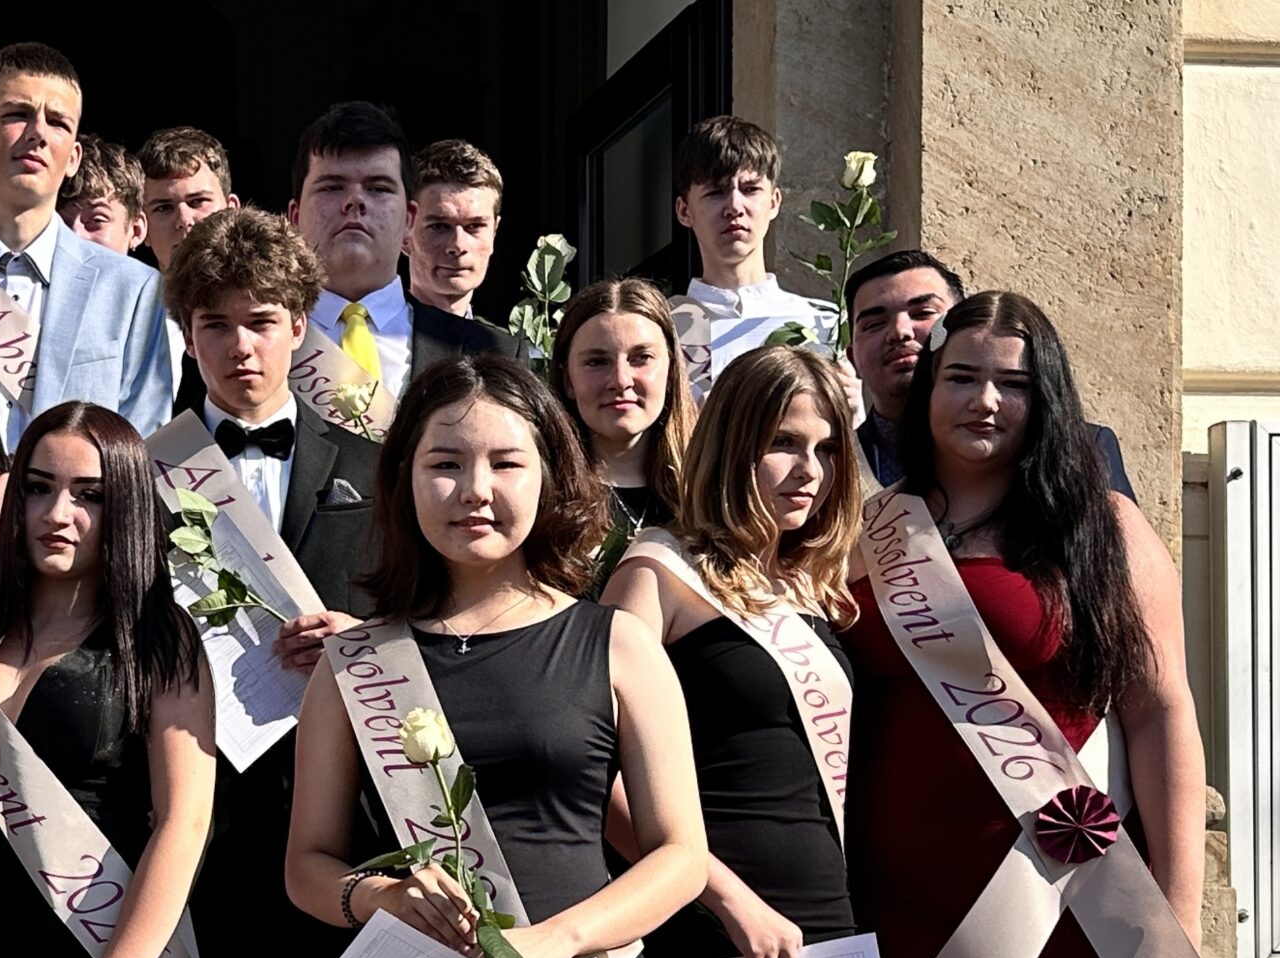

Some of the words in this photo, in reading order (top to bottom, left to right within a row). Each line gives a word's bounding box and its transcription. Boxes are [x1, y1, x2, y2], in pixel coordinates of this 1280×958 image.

[336, 620, 430, 778] bsolvent
[863, 492, 955, 648] Absolvent
[940, 672, 1066, 781] 2026
[38, 854, 124, 943] 202
